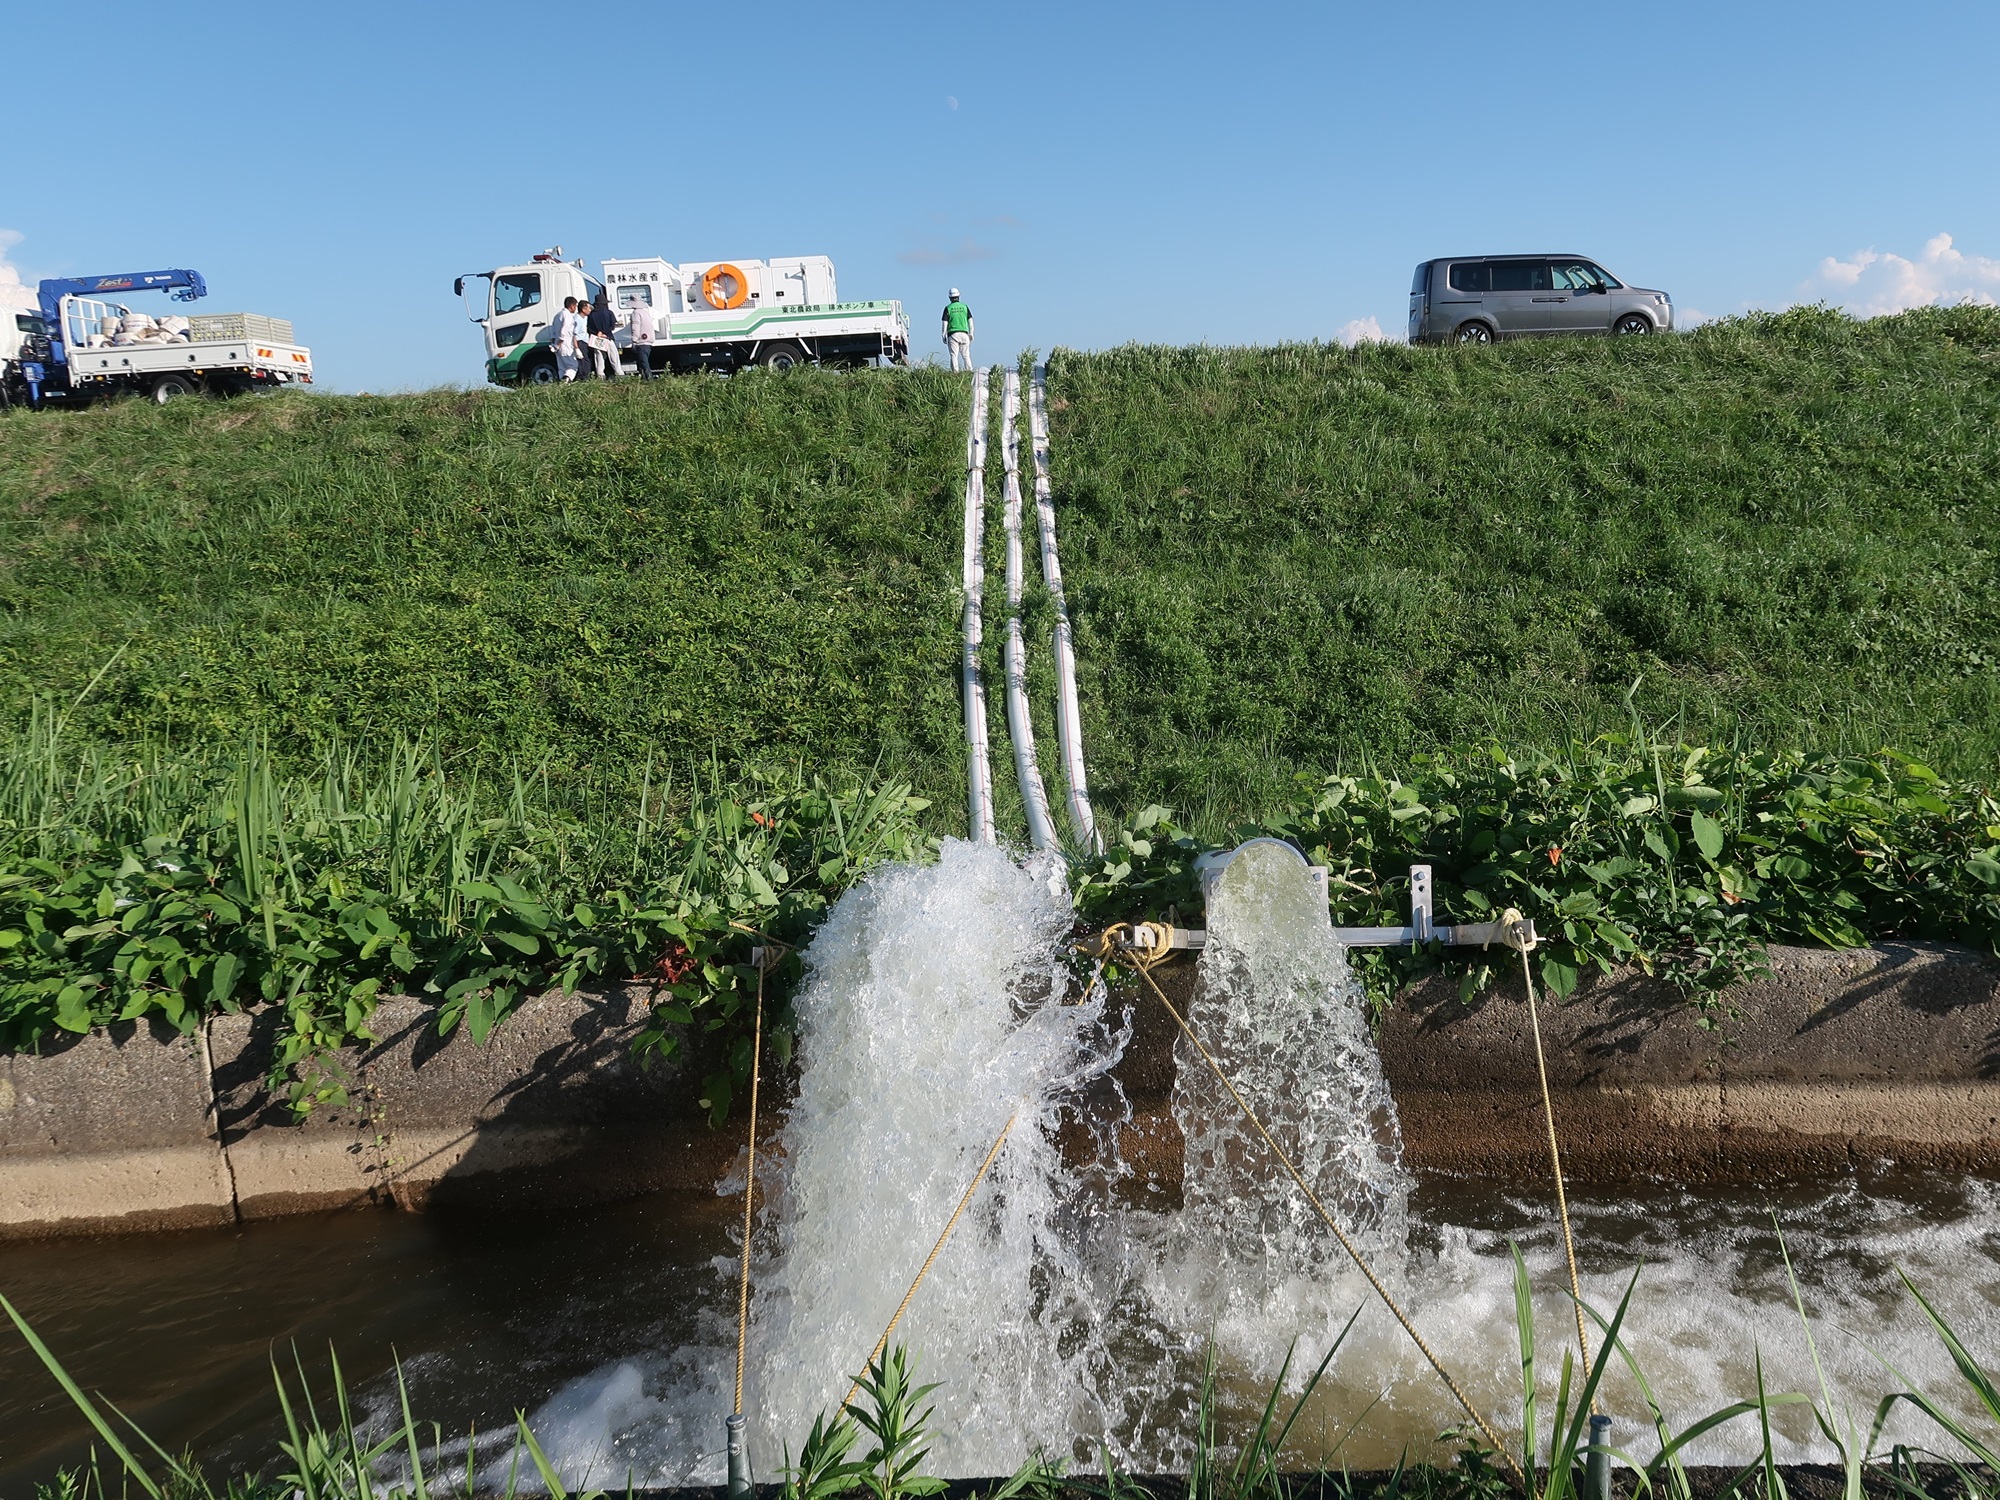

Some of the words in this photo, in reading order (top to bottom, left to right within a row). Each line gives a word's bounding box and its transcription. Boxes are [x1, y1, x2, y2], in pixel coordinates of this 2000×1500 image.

[607, 272, 658, 284] 農林水産省
[782, 304, 821, 314] 東北農政局
[828, 302, 875, 311] 排水ポンプ車
